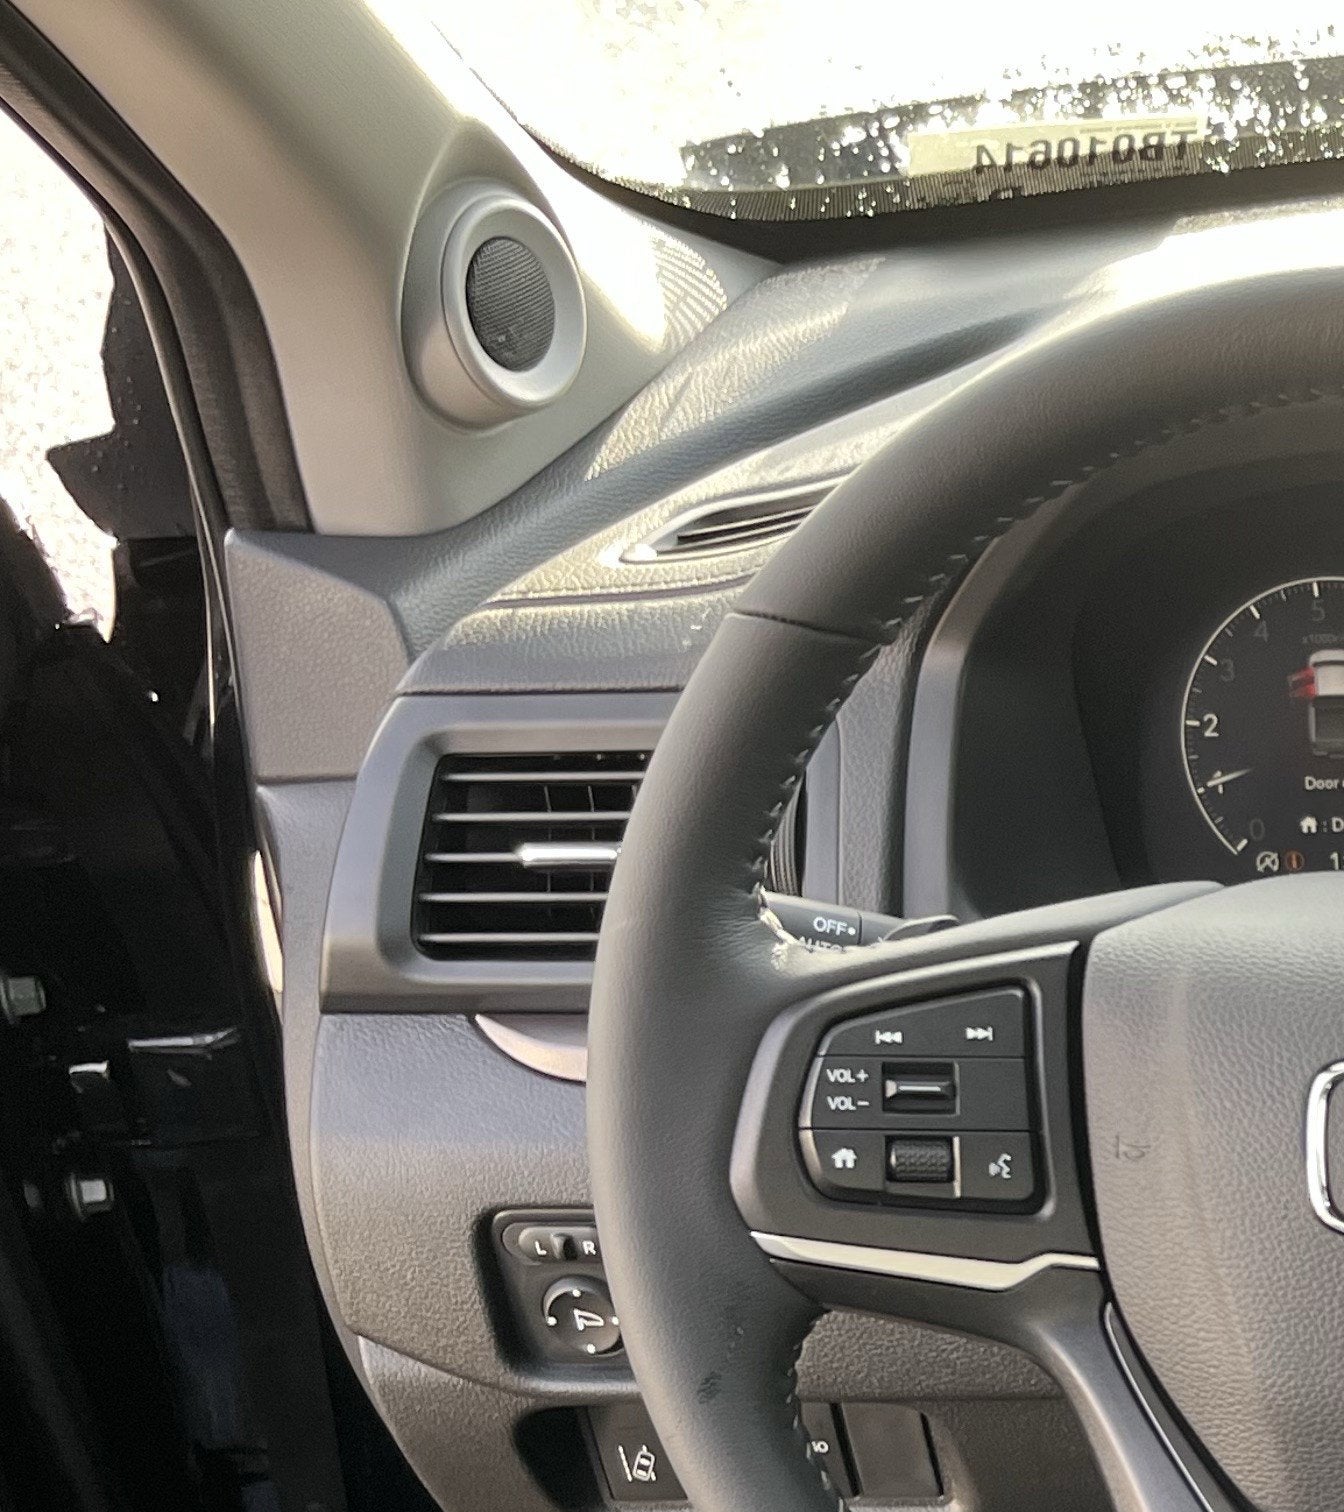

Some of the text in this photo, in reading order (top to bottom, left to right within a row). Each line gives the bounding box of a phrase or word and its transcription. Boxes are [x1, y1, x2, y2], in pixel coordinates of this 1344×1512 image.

[1203, 713, 1219, 737] 2
[1304, 776, 1338, 791] Door
[813, 916, 848, 936] OFF
[534, 1241, 596, 1255] L R
